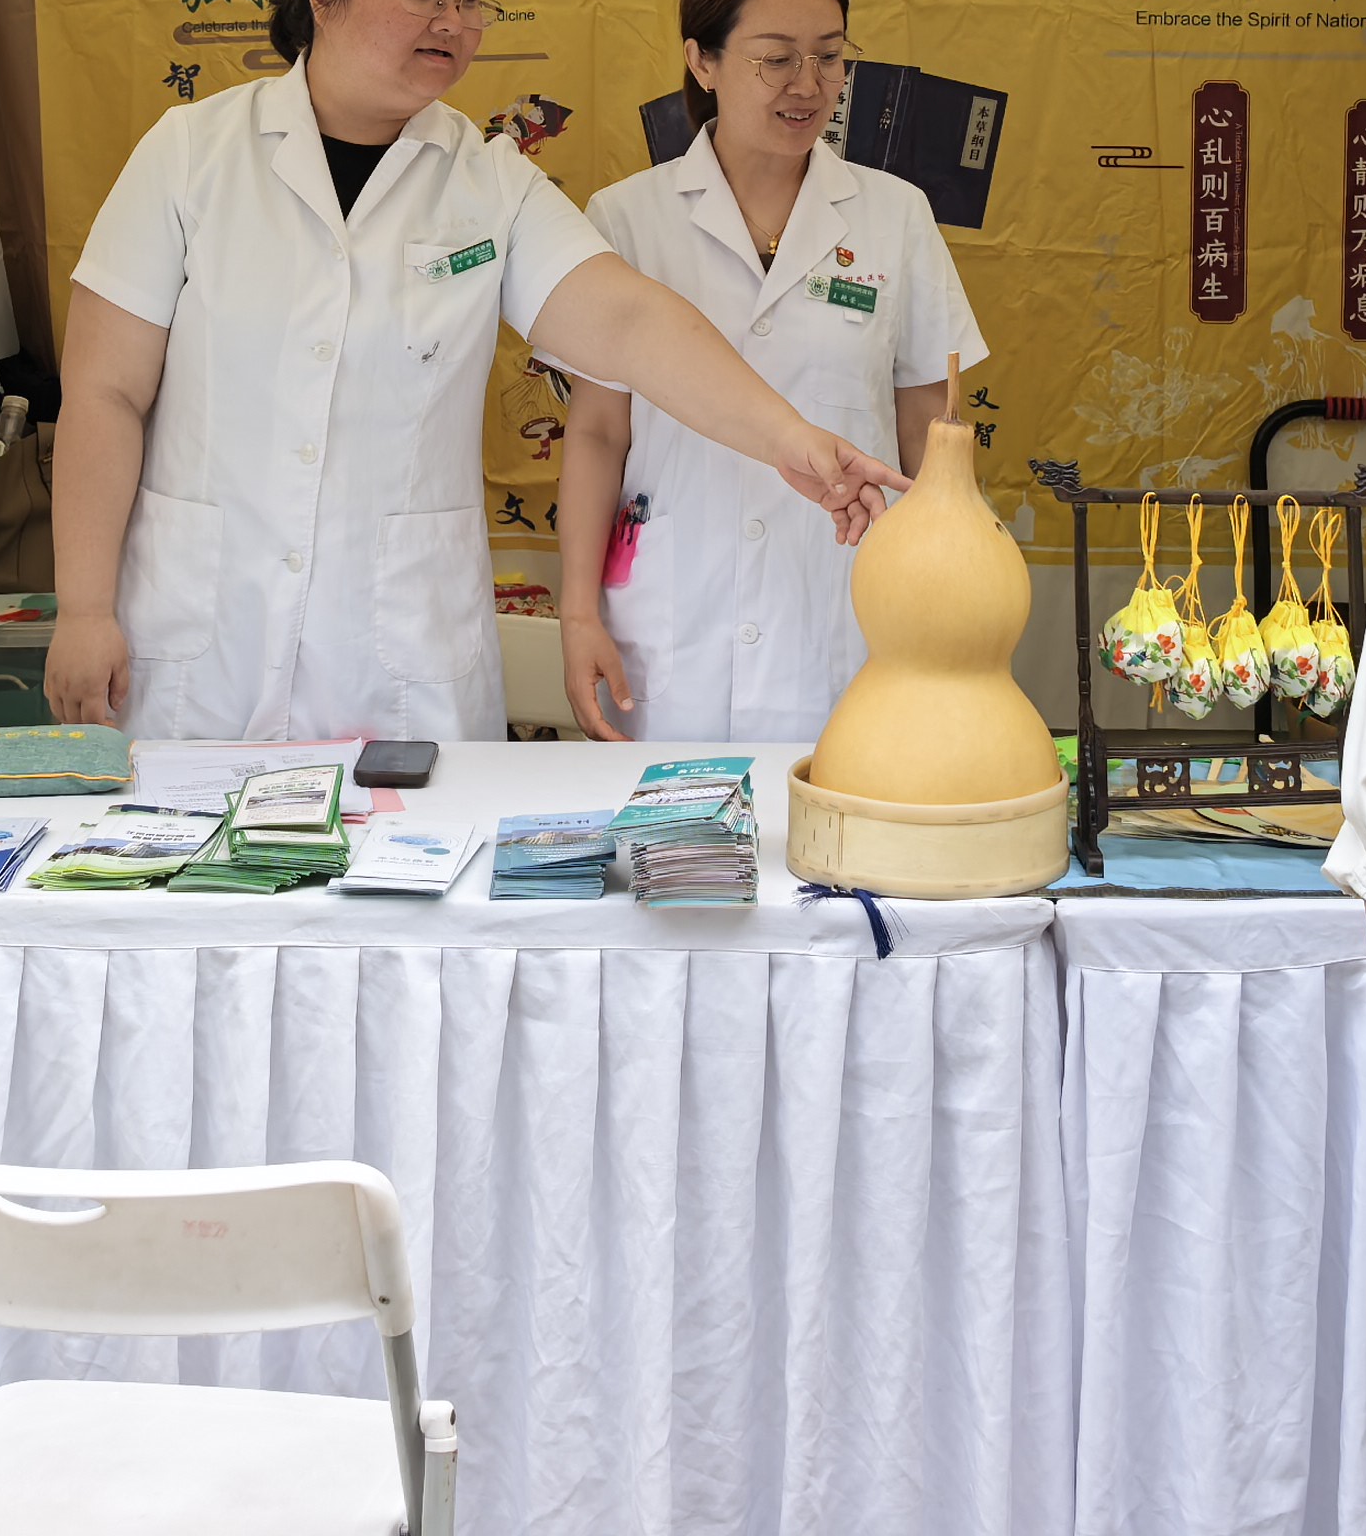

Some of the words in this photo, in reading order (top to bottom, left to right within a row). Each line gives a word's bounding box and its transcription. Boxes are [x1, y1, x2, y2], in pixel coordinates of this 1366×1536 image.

[1135, 10, 1211, 27] Embrace
[1216, 11, 1243, 27] the
[1247, 11, 1292, 31] Spirit
[1295, 11, 1313, 28] of
[162, 61, 202, 101] 智
[968, 105, 992, 162] 本草纲目
[1197, 107, 1234, 303] 心乱则百病生
